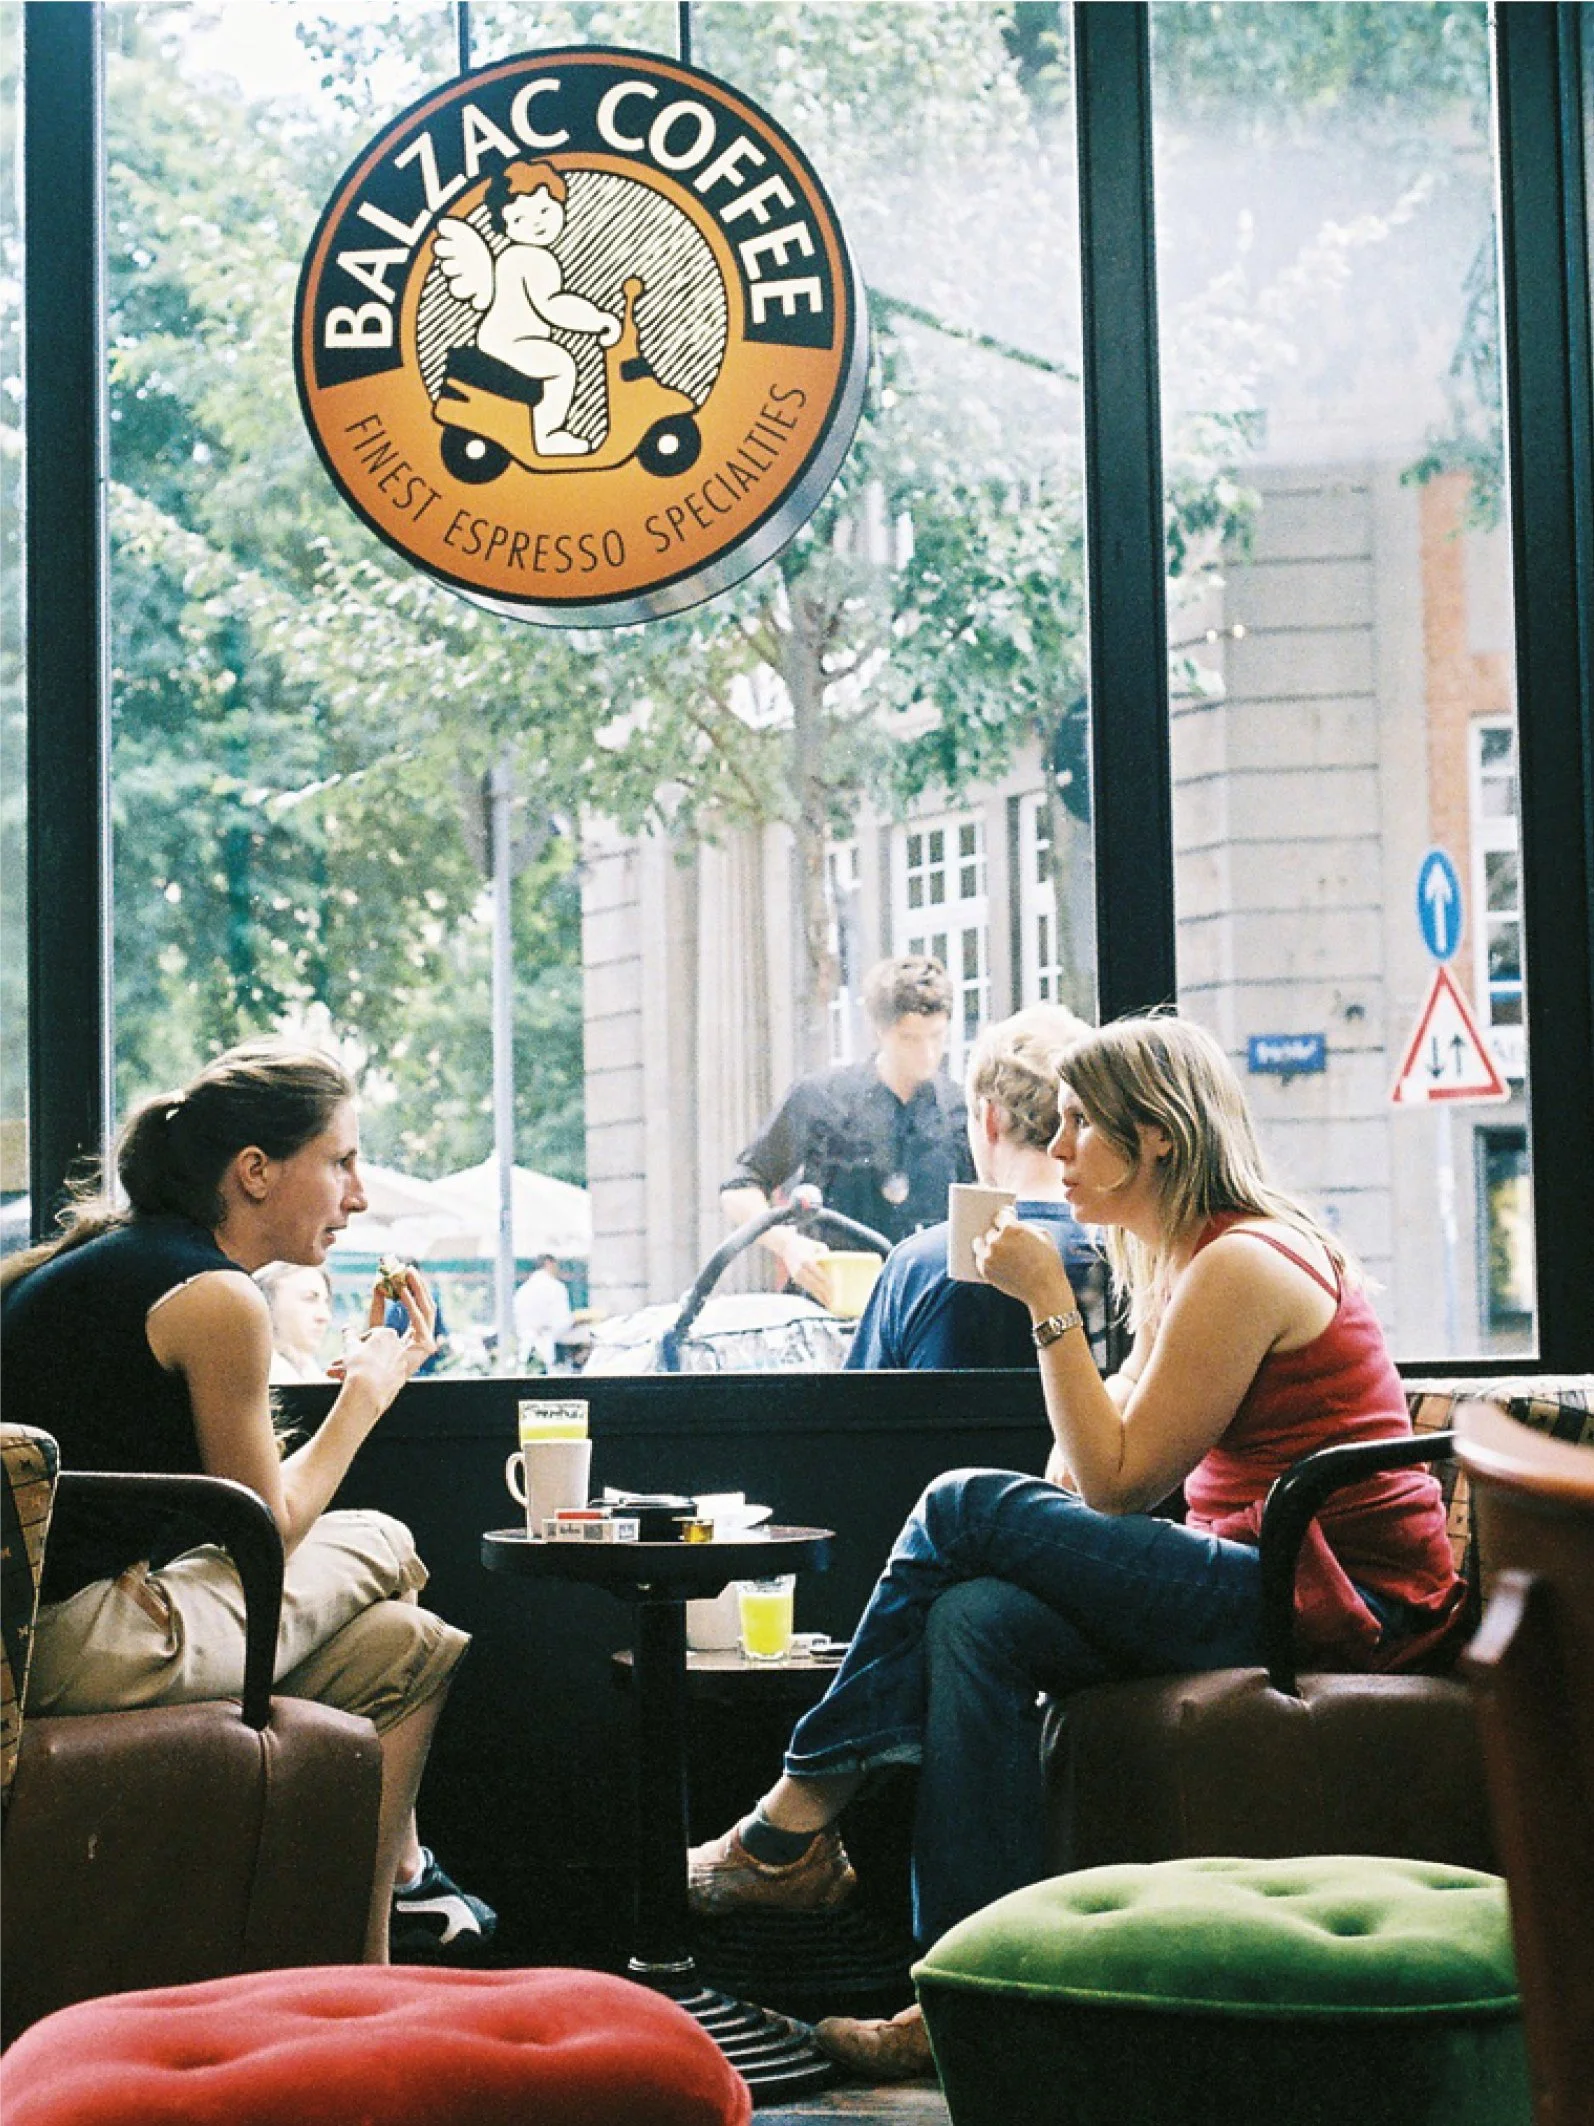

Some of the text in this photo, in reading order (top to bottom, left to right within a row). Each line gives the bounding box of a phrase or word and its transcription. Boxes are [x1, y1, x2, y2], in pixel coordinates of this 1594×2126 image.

[325, 78, 823, 350] BALZAC COFFEE
[345, 383, 807, 573] FINEST ESPRESSO SPECIALTIES
